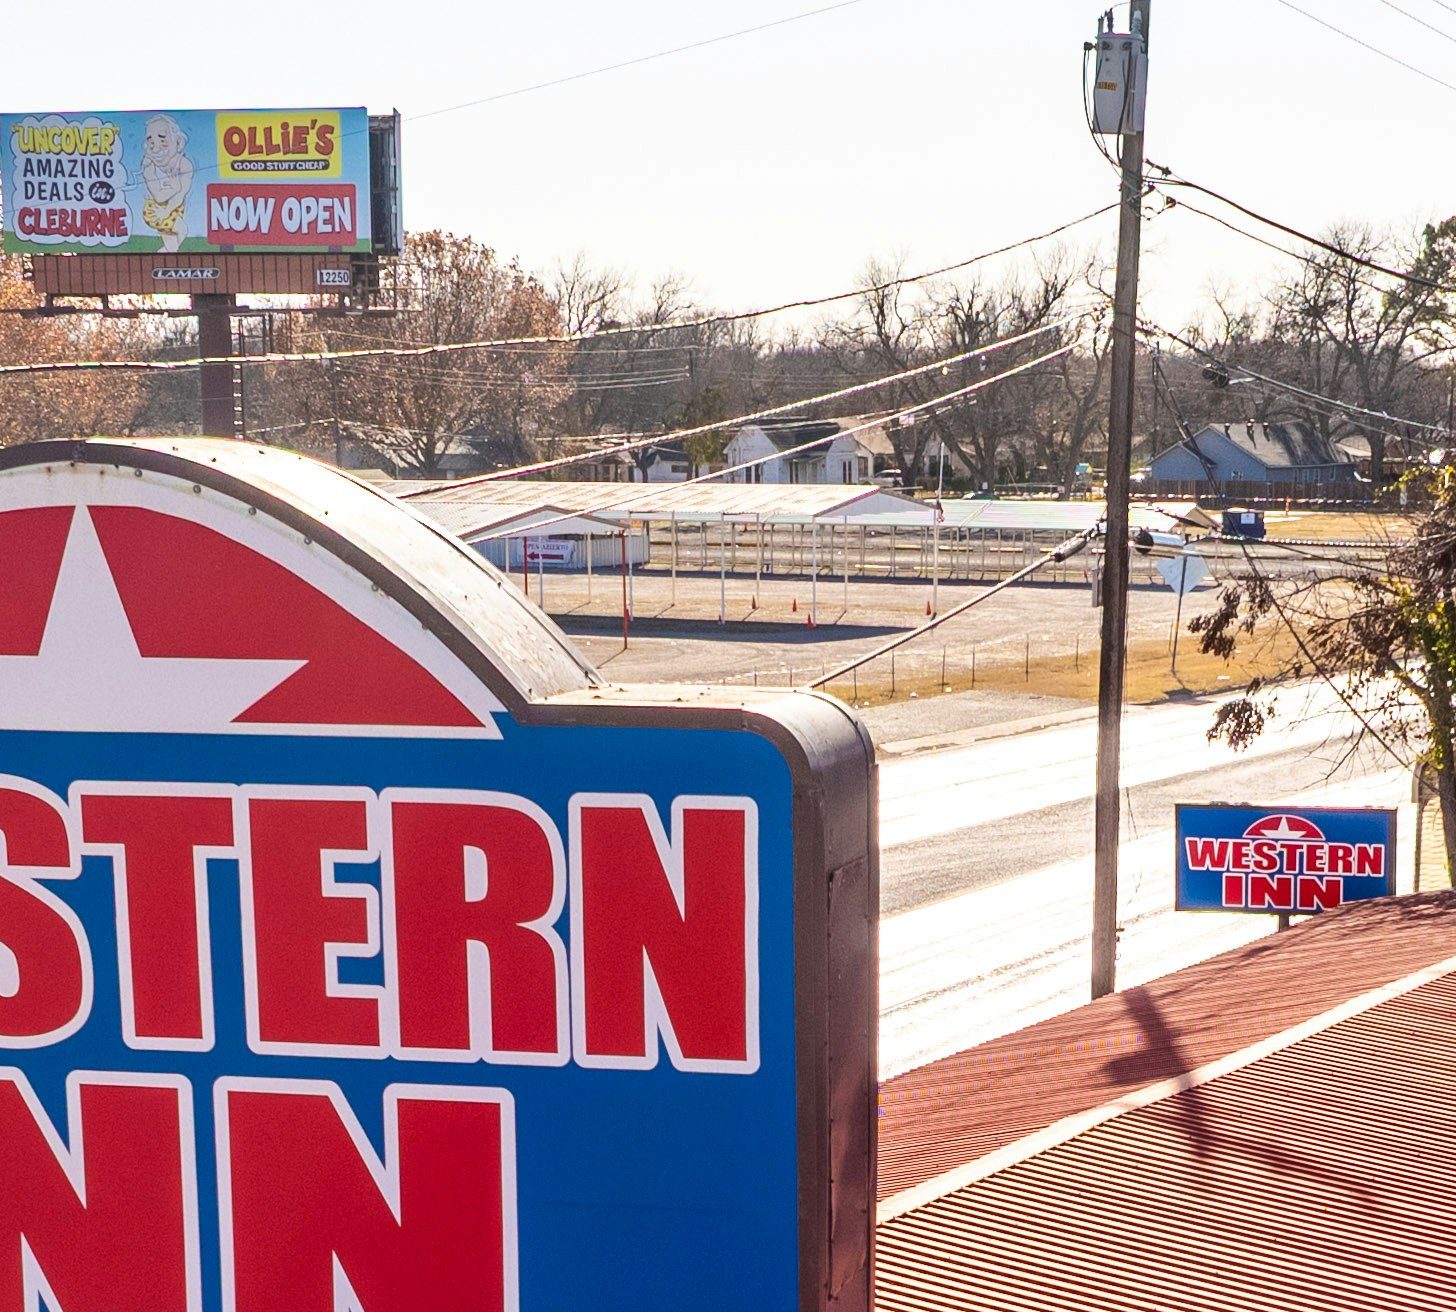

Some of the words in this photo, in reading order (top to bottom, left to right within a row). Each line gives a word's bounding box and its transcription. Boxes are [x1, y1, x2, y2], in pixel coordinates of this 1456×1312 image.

[23, 158, 115, 179] AMAZING
[266, 161, 295, 171] STUFF
[24, 181, 84, 201] DEALS
[18, 207, 129, 238] CLEBURNE
[211, 195, 275, 235] NOW
[281, 196, 352, 235] OPEN
[157, 269, 213, 279] LAMAR
[320, 271, 349, 284] 12250
[1185, 837, 1385, 877] WESTERN
[1222, 872, 1344, 909] INN
